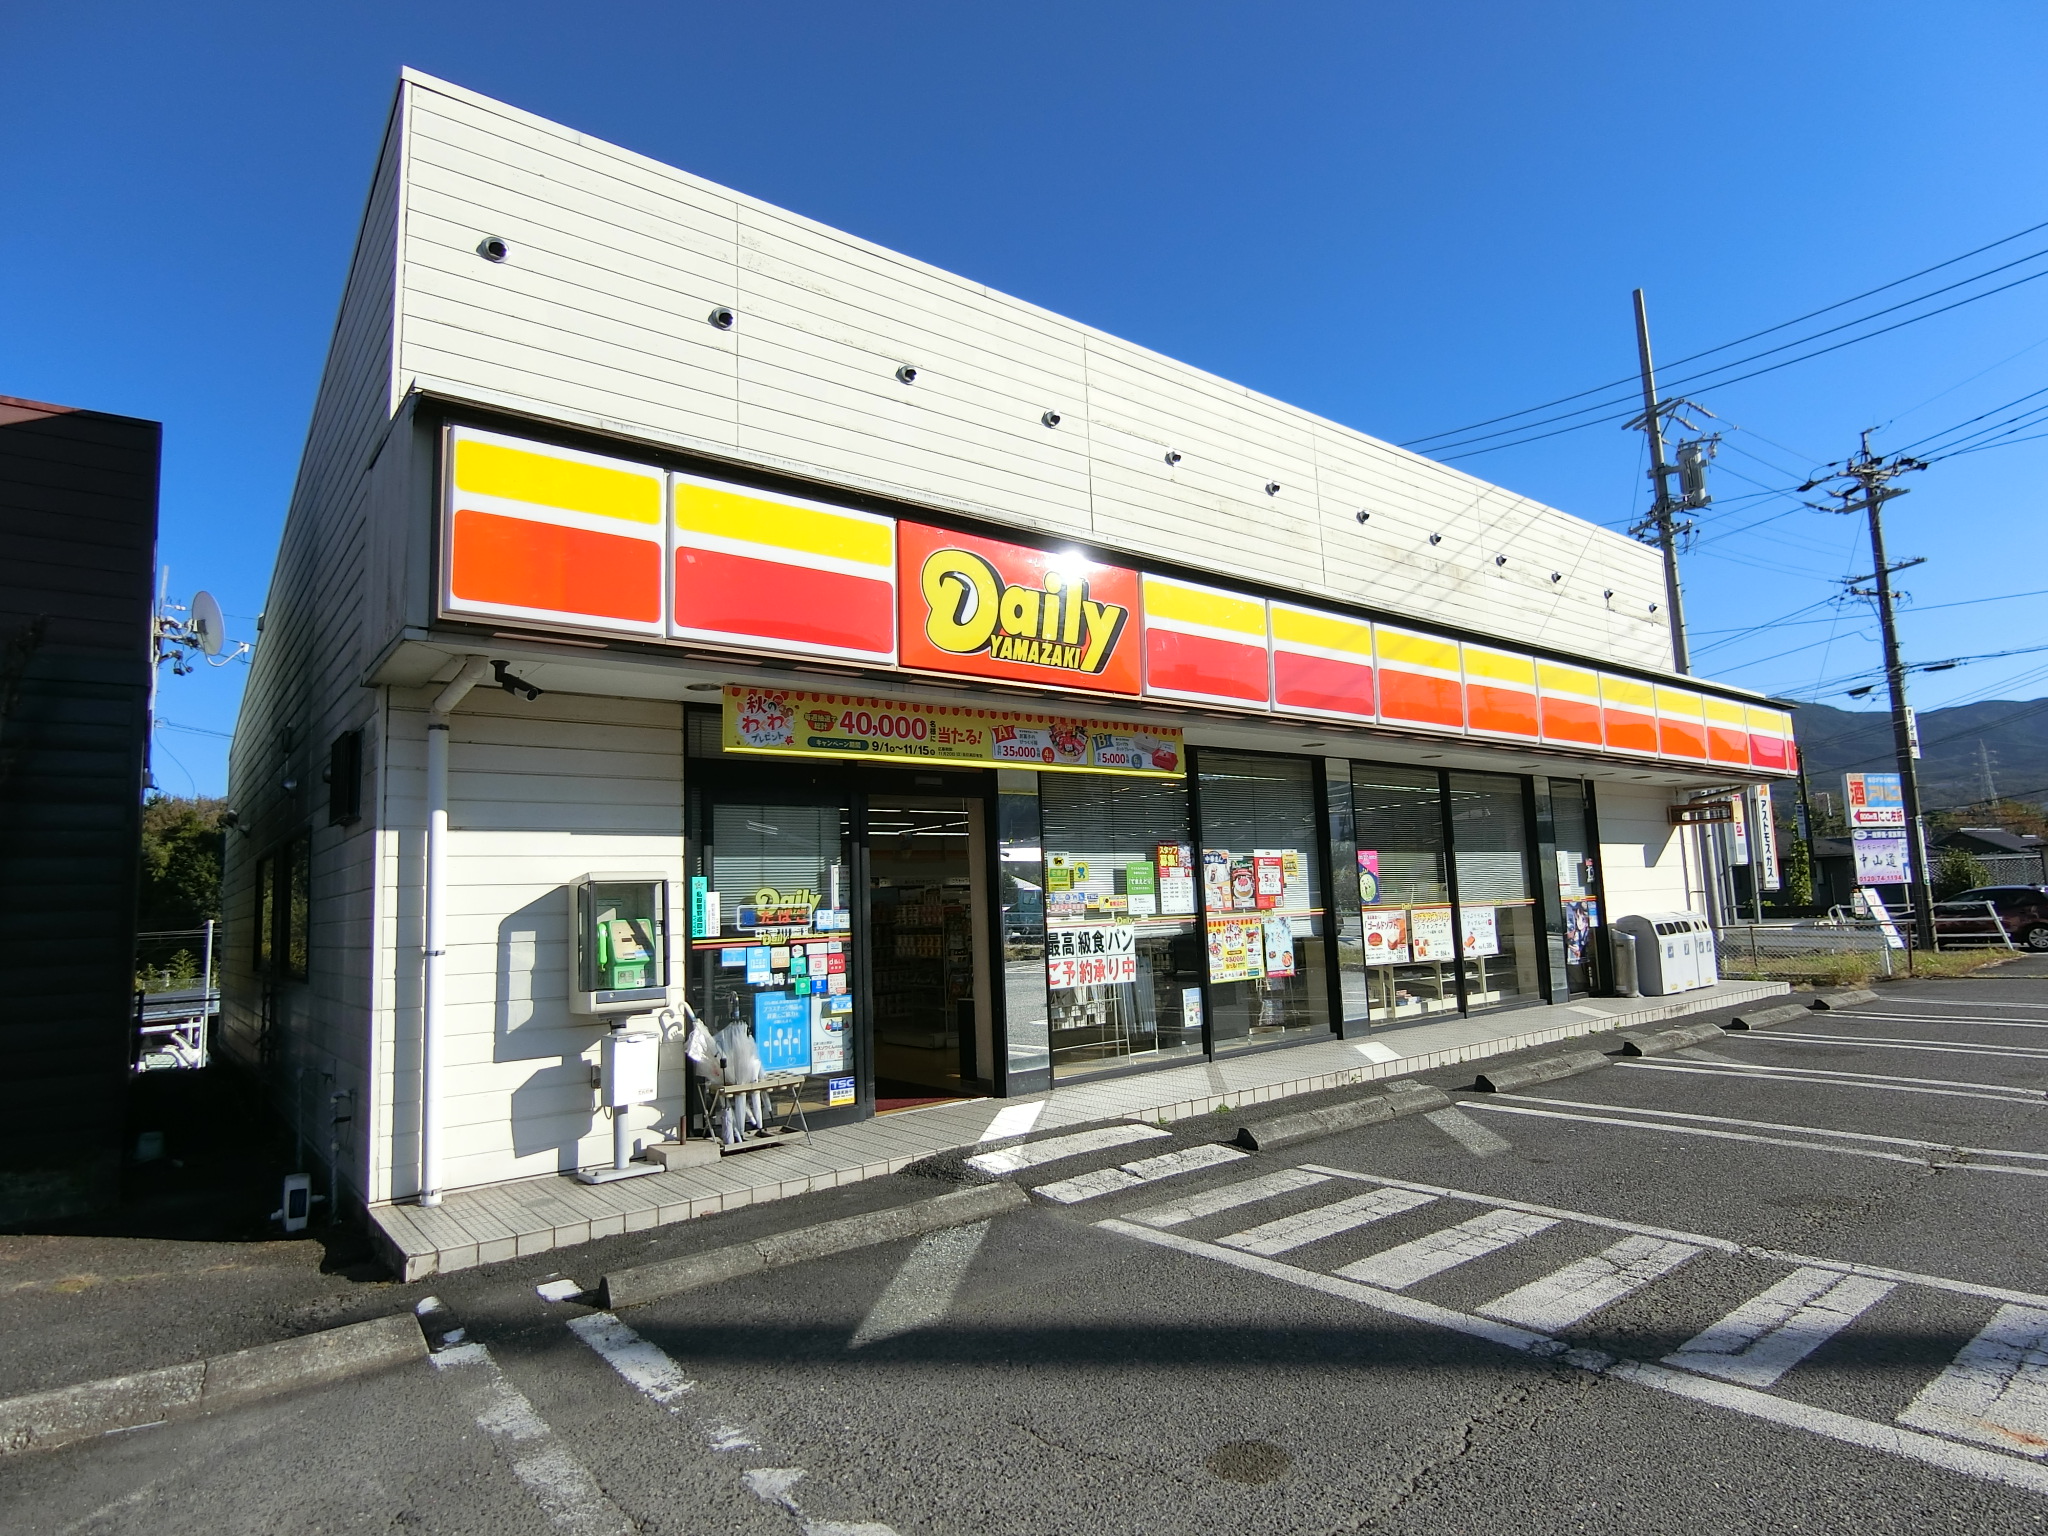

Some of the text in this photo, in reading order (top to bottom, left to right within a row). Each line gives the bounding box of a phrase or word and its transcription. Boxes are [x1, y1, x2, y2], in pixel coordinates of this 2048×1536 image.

[921, 549, 1126, 674] Daily
[991, 634, 1081, 669] YAMAZAKI
[746, 694, 777, 714] 秋の
[742, 713, 790, 733] わくわく
[840, 710, 928, 741] 40,000
[751, 731, 784, 743] プレゼント
[1002, 745, 1037, 758] 35,000
[1102, 752, 1127, 764] 5,000
[1849, 781, 1865, 805] 酒
[1760, 799, 1774, 878] アストモスガス
[1859, 852, 1898, 869] 中山道
[755, 887, 822, 917] Daily
[762, 933, 788, 946] Daily
[1048, 929, 1133, 957] 最高級食パン
[1048, 956, 1135, 986] ご予約承り中
[830, 1078, 855, 1089] TSC
